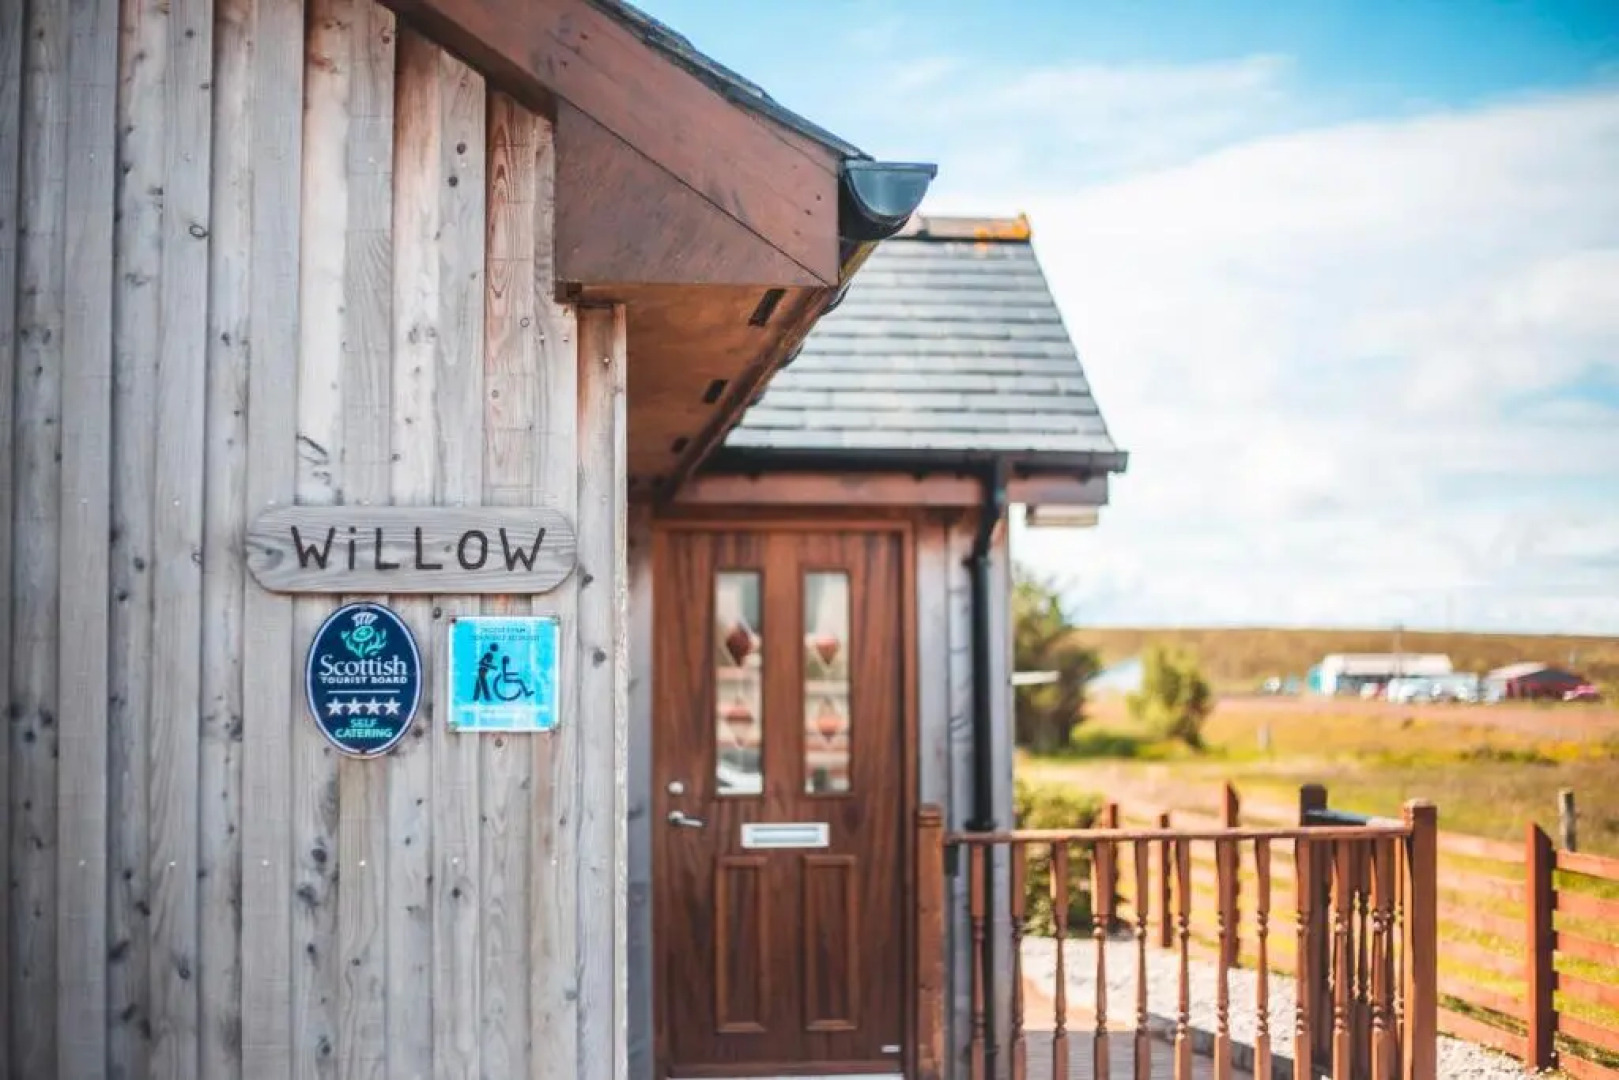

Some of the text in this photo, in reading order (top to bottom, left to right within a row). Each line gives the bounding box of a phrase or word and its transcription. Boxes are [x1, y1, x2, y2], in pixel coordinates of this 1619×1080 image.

[319, 654, 408, 676] Scottish
[321, 676, 408, 685] TOURIST BOARD
[350, 718, 378, 728] SELF
[334, 728, 393, 738] CATERING
